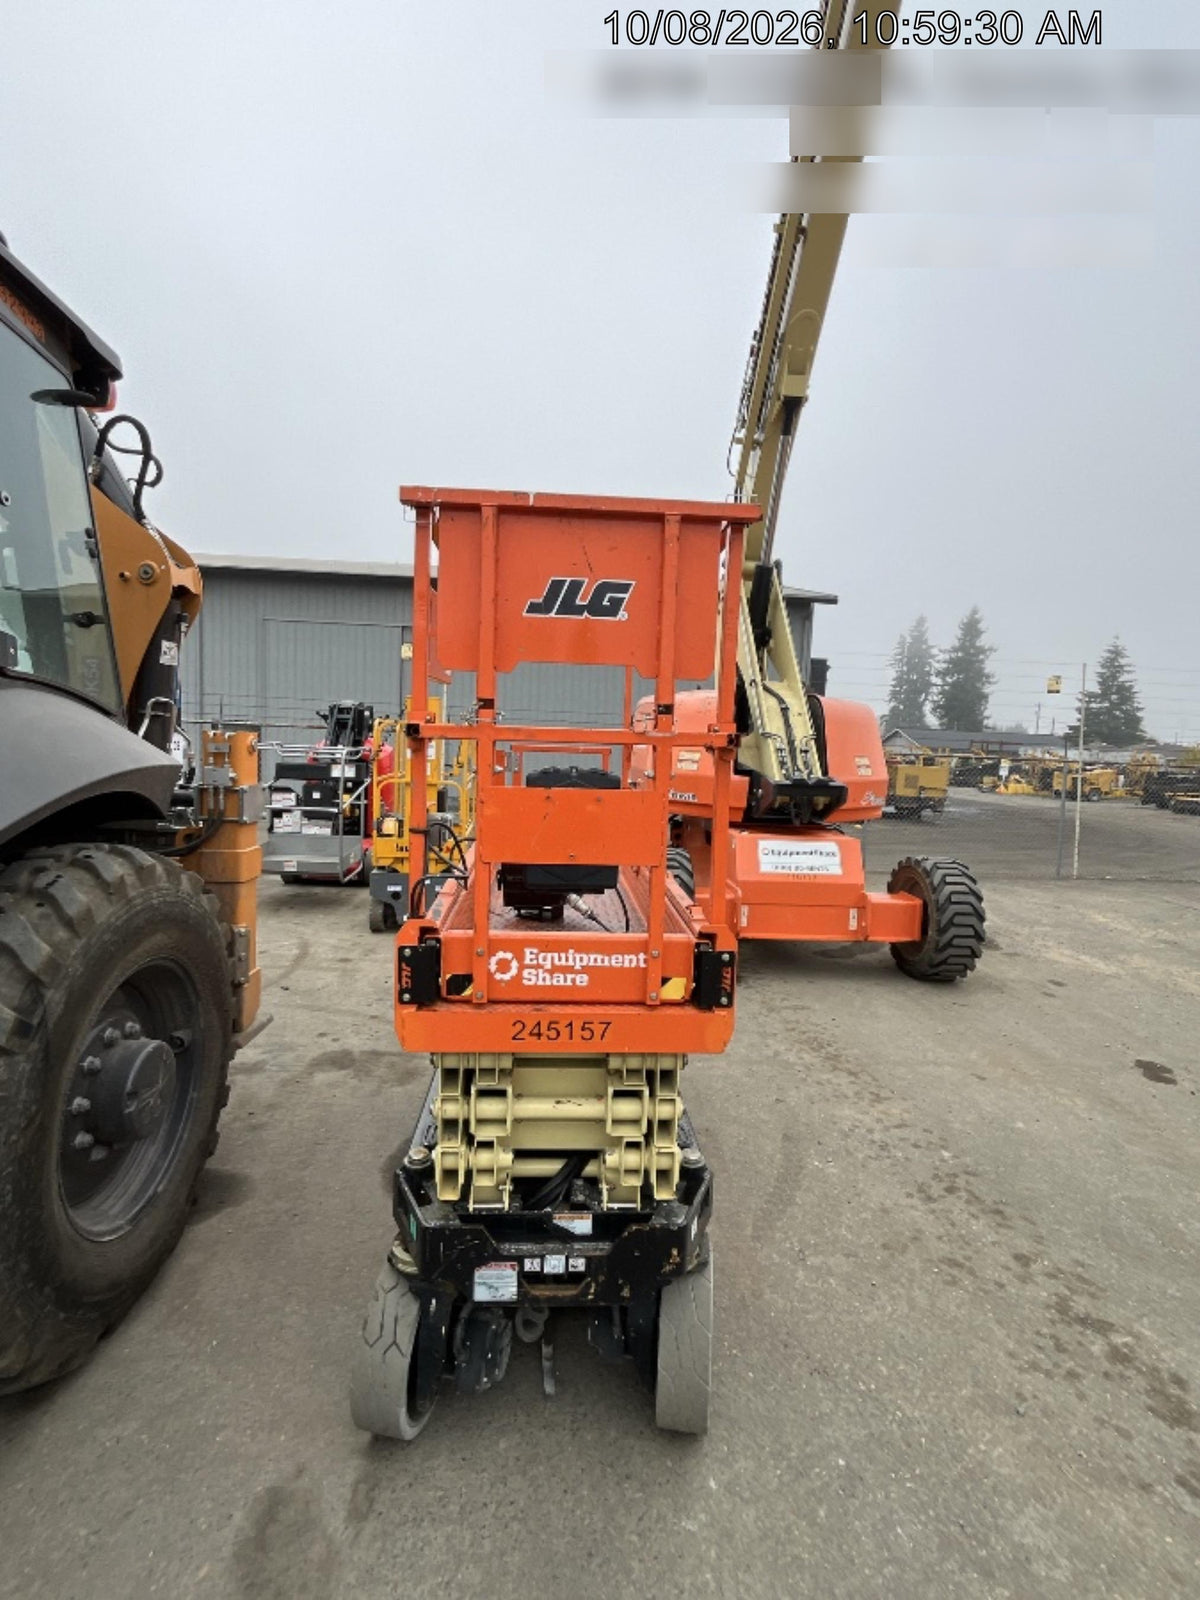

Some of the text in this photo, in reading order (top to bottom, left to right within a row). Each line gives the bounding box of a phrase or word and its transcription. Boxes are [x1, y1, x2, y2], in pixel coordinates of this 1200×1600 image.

[522, 577, 637, 620] JLG
[523, 948, 648, 969] Equipment
[522, 968, 589, 986] Share
[511, 1019, 613, 1041] 245157
